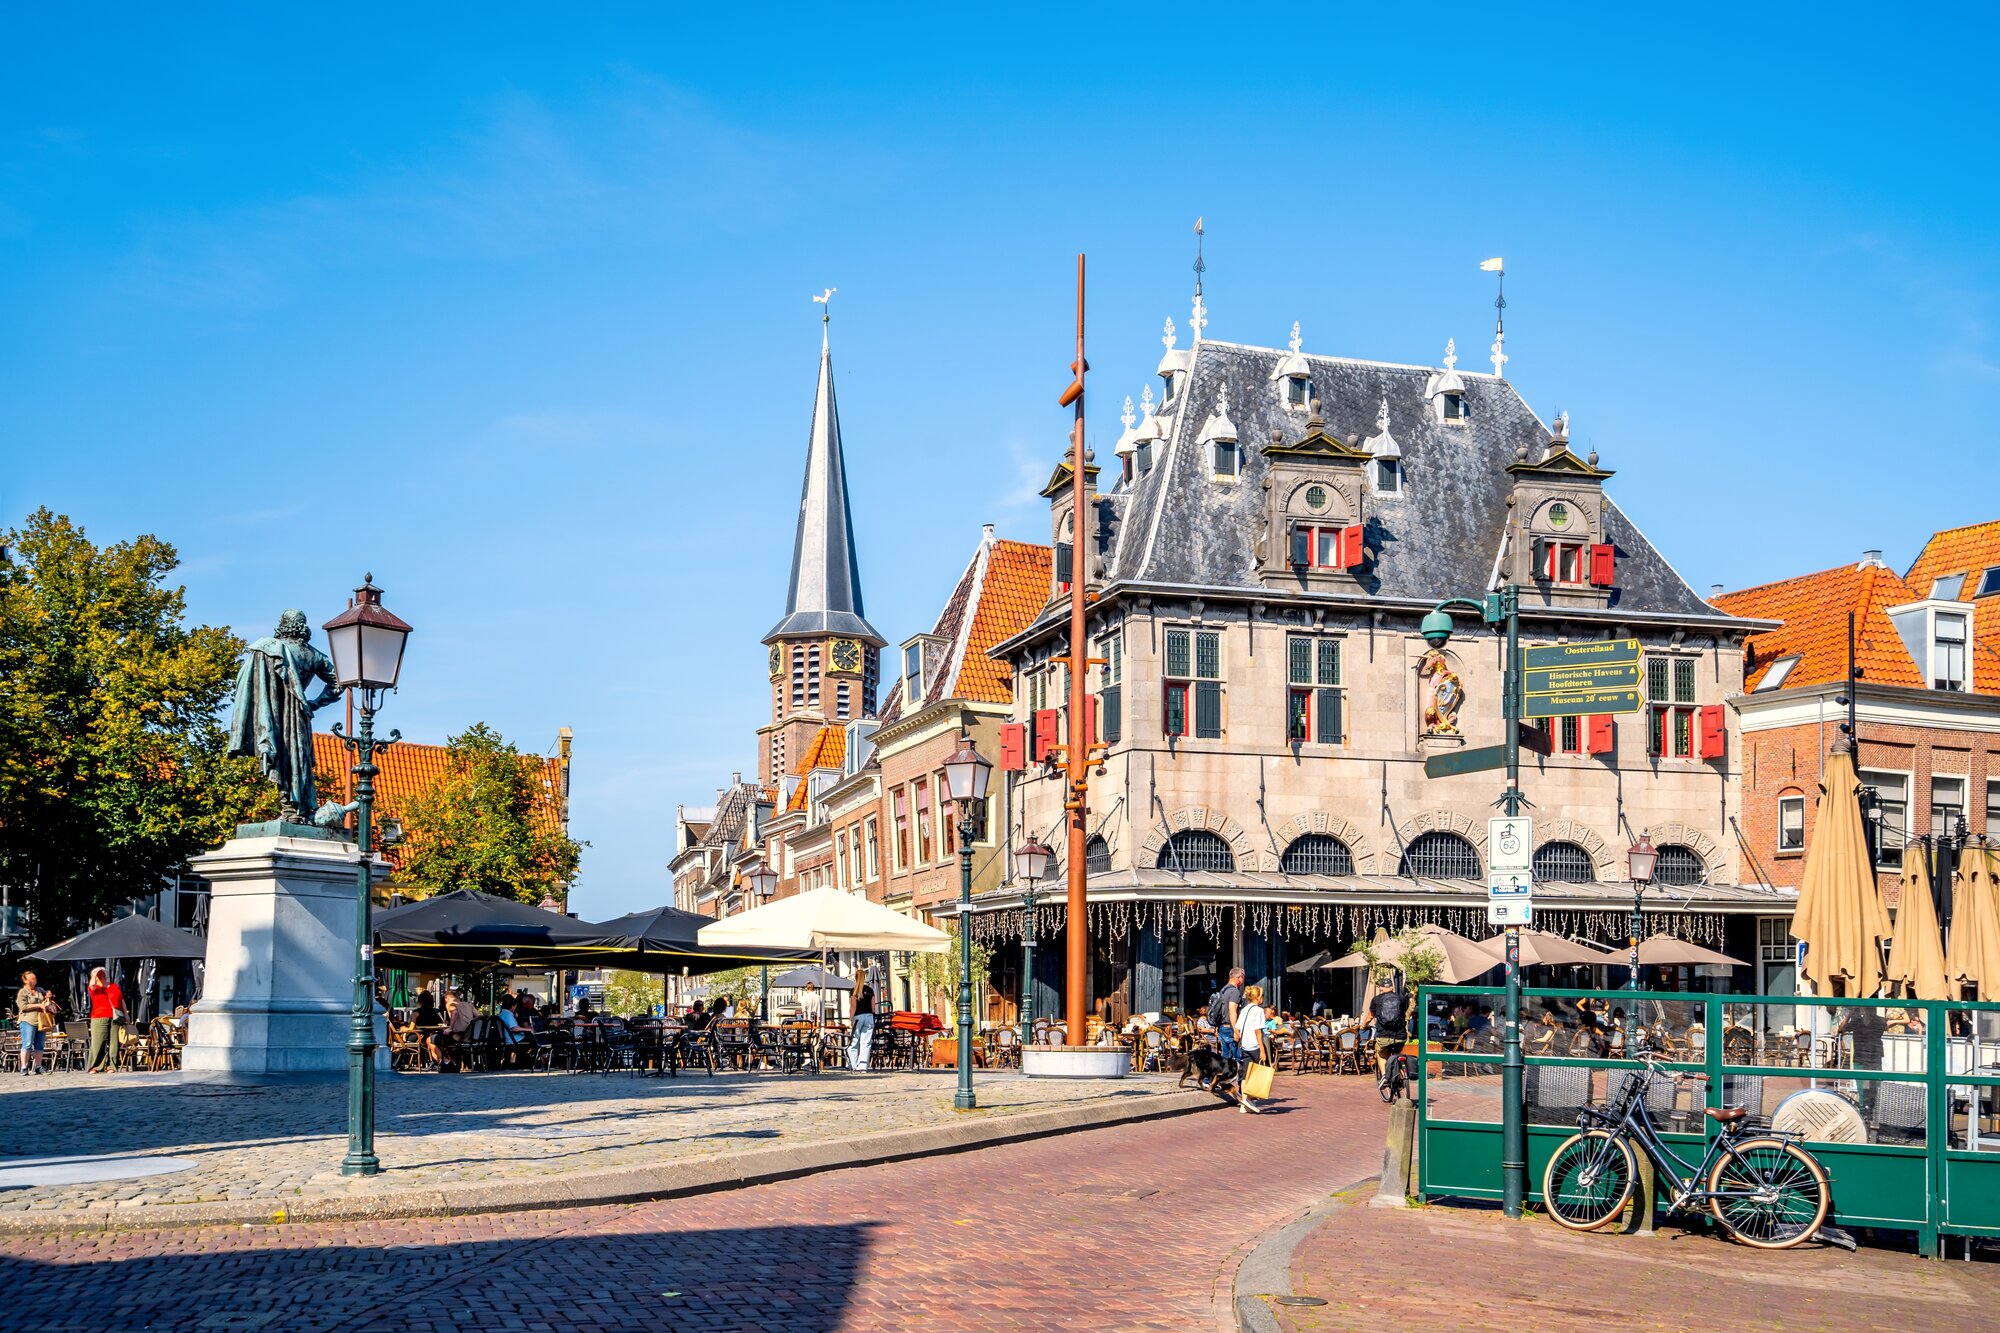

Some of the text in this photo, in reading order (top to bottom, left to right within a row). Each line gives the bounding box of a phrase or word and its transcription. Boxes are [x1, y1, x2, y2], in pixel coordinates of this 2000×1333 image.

[1565, 644, 1614, 654] Oostereiland
[1549, 669, 1622, 680] Historische Havens
[1549, 680, 1592, 688] Hoofdtoren
[1503, 840, 1515, 850] 62
